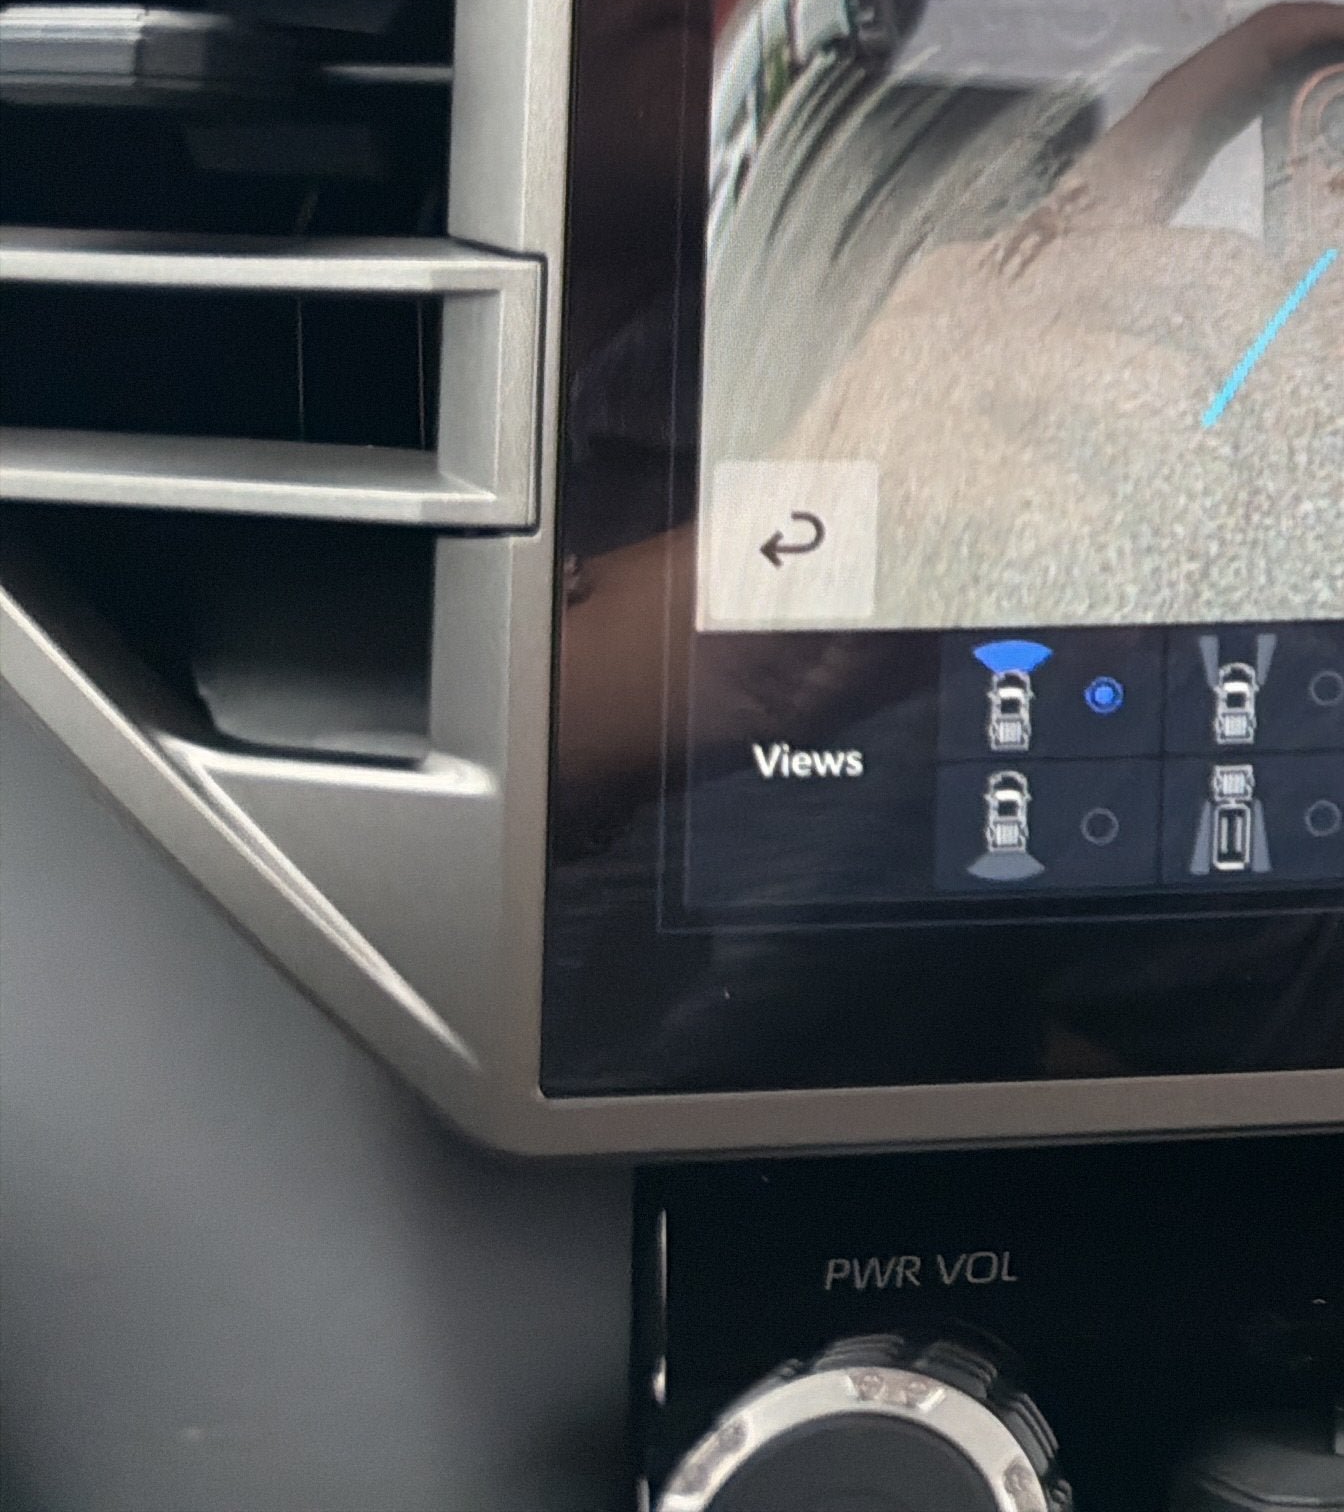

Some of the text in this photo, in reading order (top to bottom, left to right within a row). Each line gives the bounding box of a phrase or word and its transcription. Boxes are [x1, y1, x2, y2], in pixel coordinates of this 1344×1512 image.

[752, 743, 865, 778] Views
[823, 1250, 1020, 1290] PWR VOL
